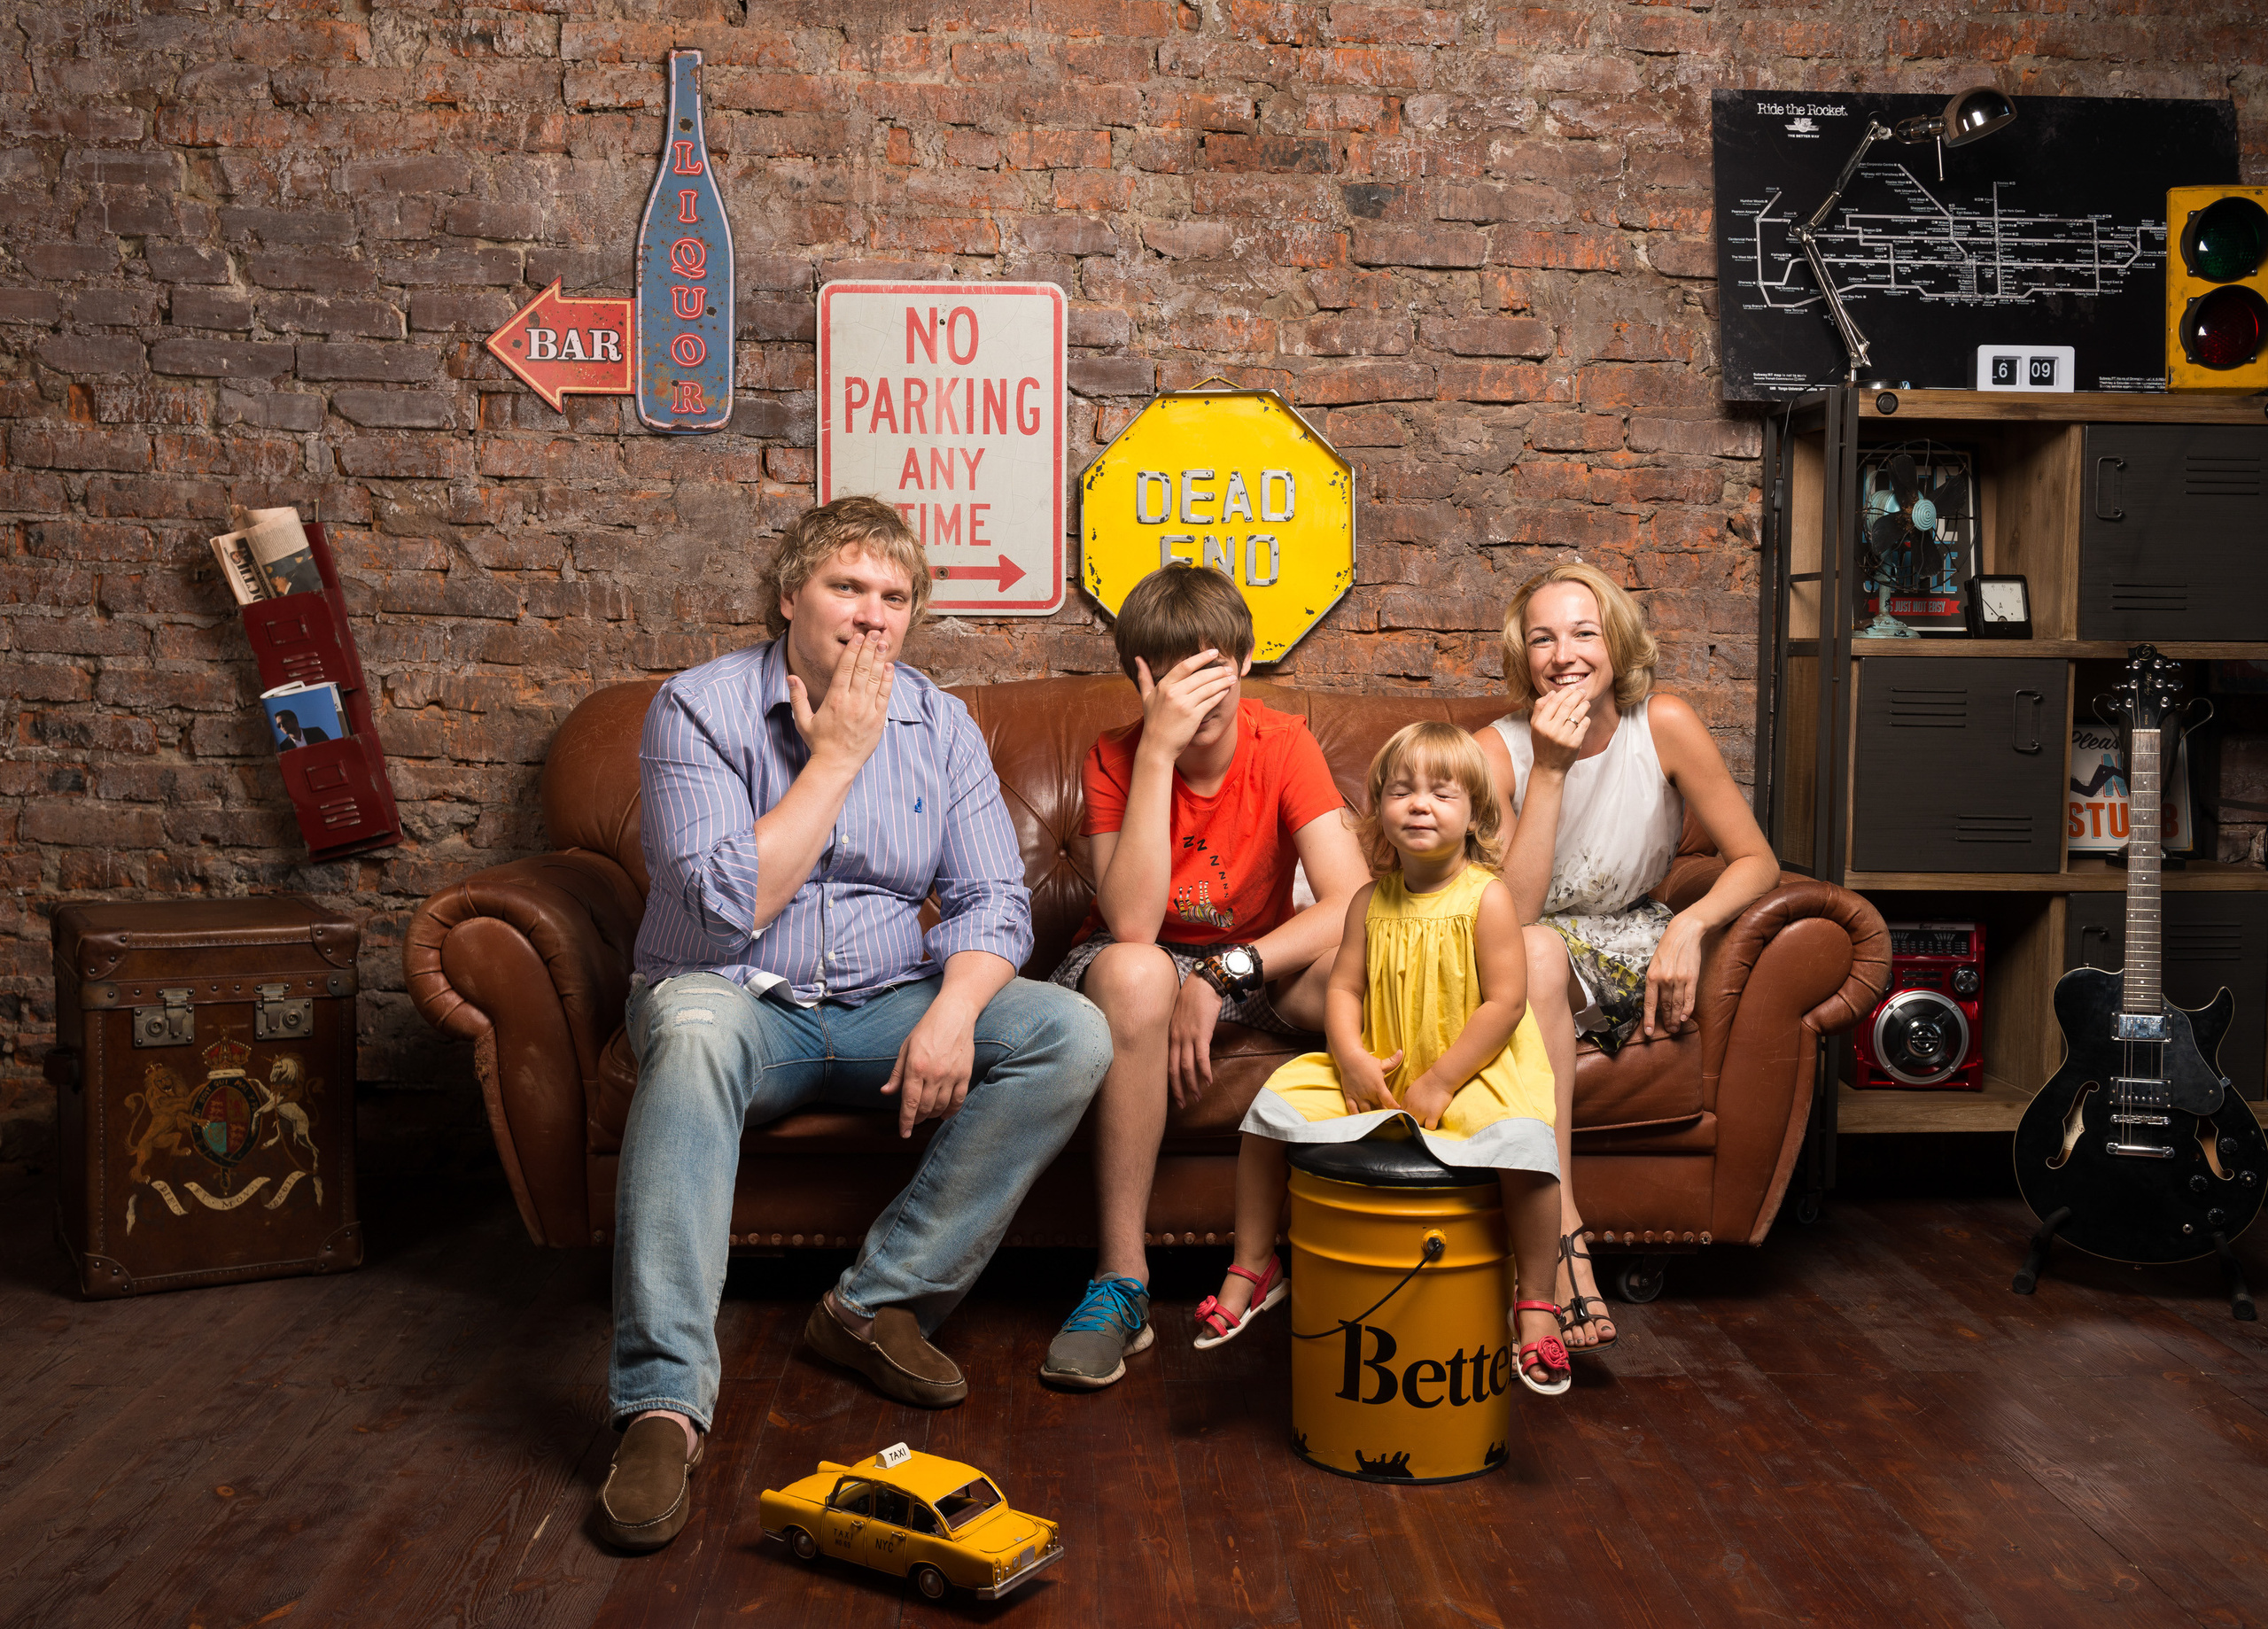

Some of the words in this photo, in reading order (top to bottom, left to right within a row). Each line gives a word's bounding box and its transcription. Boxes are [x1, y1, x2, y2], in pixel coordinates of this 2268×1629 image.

[1757, 103, 1784, 115] Ride
[1785, 104, 1805, 115] the
[1806, 104, 1848, 116] Rocket.
[670, 139, 707, 415] LIQUOR
[525, 326, 623, 361] BAR
[905, 306, 979, 365] NO
[1999, 362, 2008, 378] 6
[2031, 362, 2051, 377] 09
[844, 376, 1041, 436] PARKING
[898, 446, 985, 490] ANY
[1136, 469, 1295, 524] DEAD
[894, 502, 991, 546] TIME
[1160, 534, 1279, 586] END
[1894, 601, 1911, 612] JUST
[1912, 601, 1927, 612] NOT
[1928, 601, 1946, 613] EASY
[2071, 731, 2120, 750] Pleas
[2068, 802, 2179, 840] STUB
[1335, 1319, 1511, 1408] Bette
[889, 1447, 907, 1462] TAXI
[834, 1528, 853, 1540] TAXI
[875, 1538, 894, 1553] NYC
